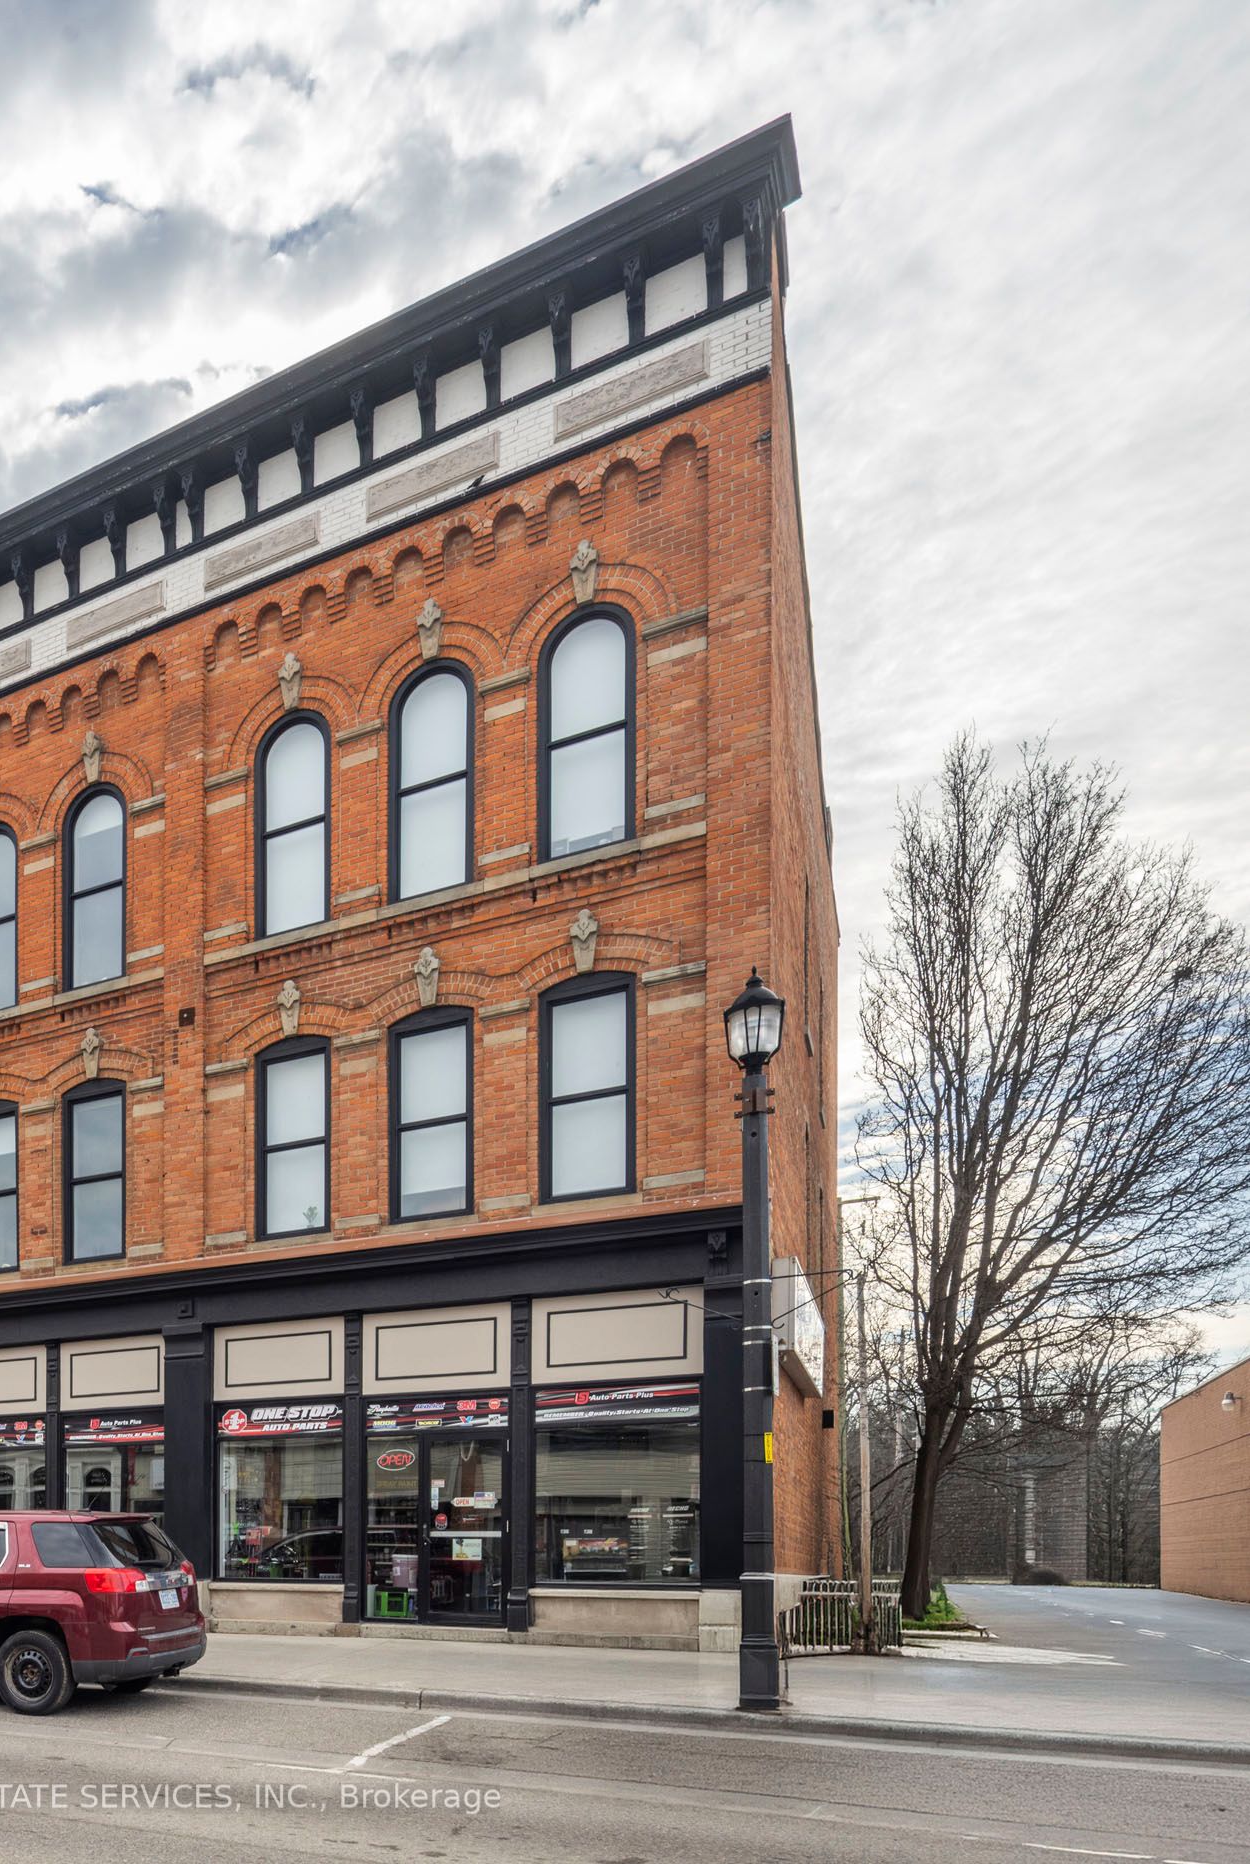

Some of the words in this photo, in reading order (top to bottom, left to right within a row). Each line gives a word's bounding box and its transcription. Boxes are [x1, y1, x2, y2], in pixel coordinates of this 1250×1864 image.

[456, 1400, 477, 1411] 3M
[251, 1407, 286, 1421] ONE
[288, 1404, 338, 1418] STOP
[14, 1421, 28, 1431] 3M
[262, 1423, 289, 1431] AUTO
[291, 1422, 328, 1430] PARTS
[379, 1453, 412, 1467] OPEN
